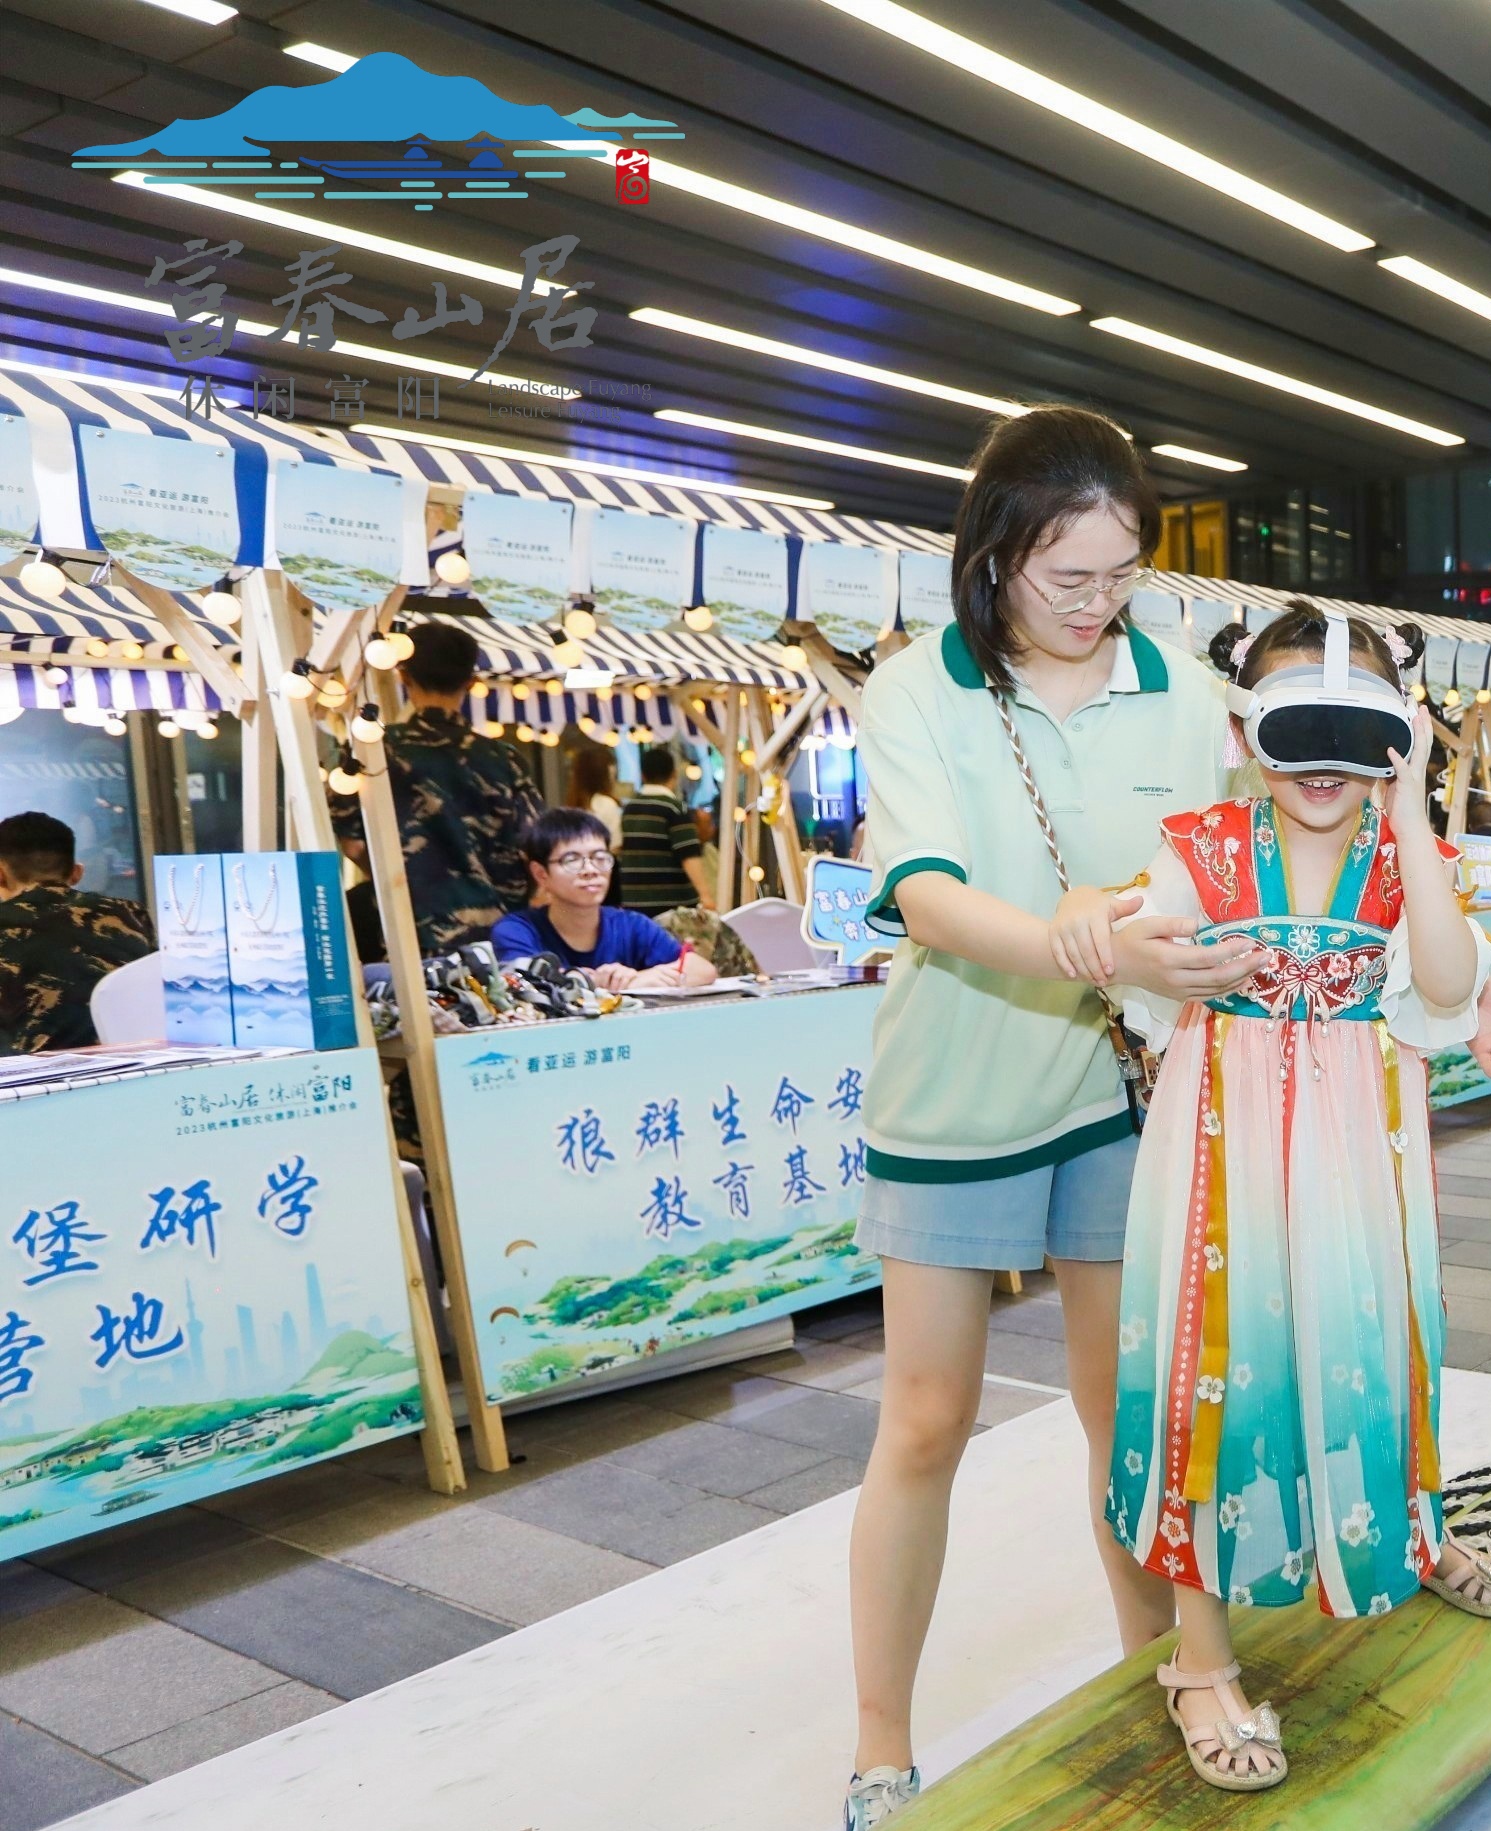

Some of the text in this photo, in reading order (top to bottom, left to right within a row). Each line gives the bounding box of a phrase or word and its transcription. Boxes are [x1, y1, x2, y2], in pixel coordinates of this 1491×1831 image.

[175, 1075, 352, 1117] 富春山居 休闲富阳
[527, 1045, 631, 1073] 看亚运 游富阳
[557, 1068, 864, 1174] 狼群生命安
[12, 1155, 318, 1286] 堡研学
[640, 1137, 867, 1238] 教育基地
